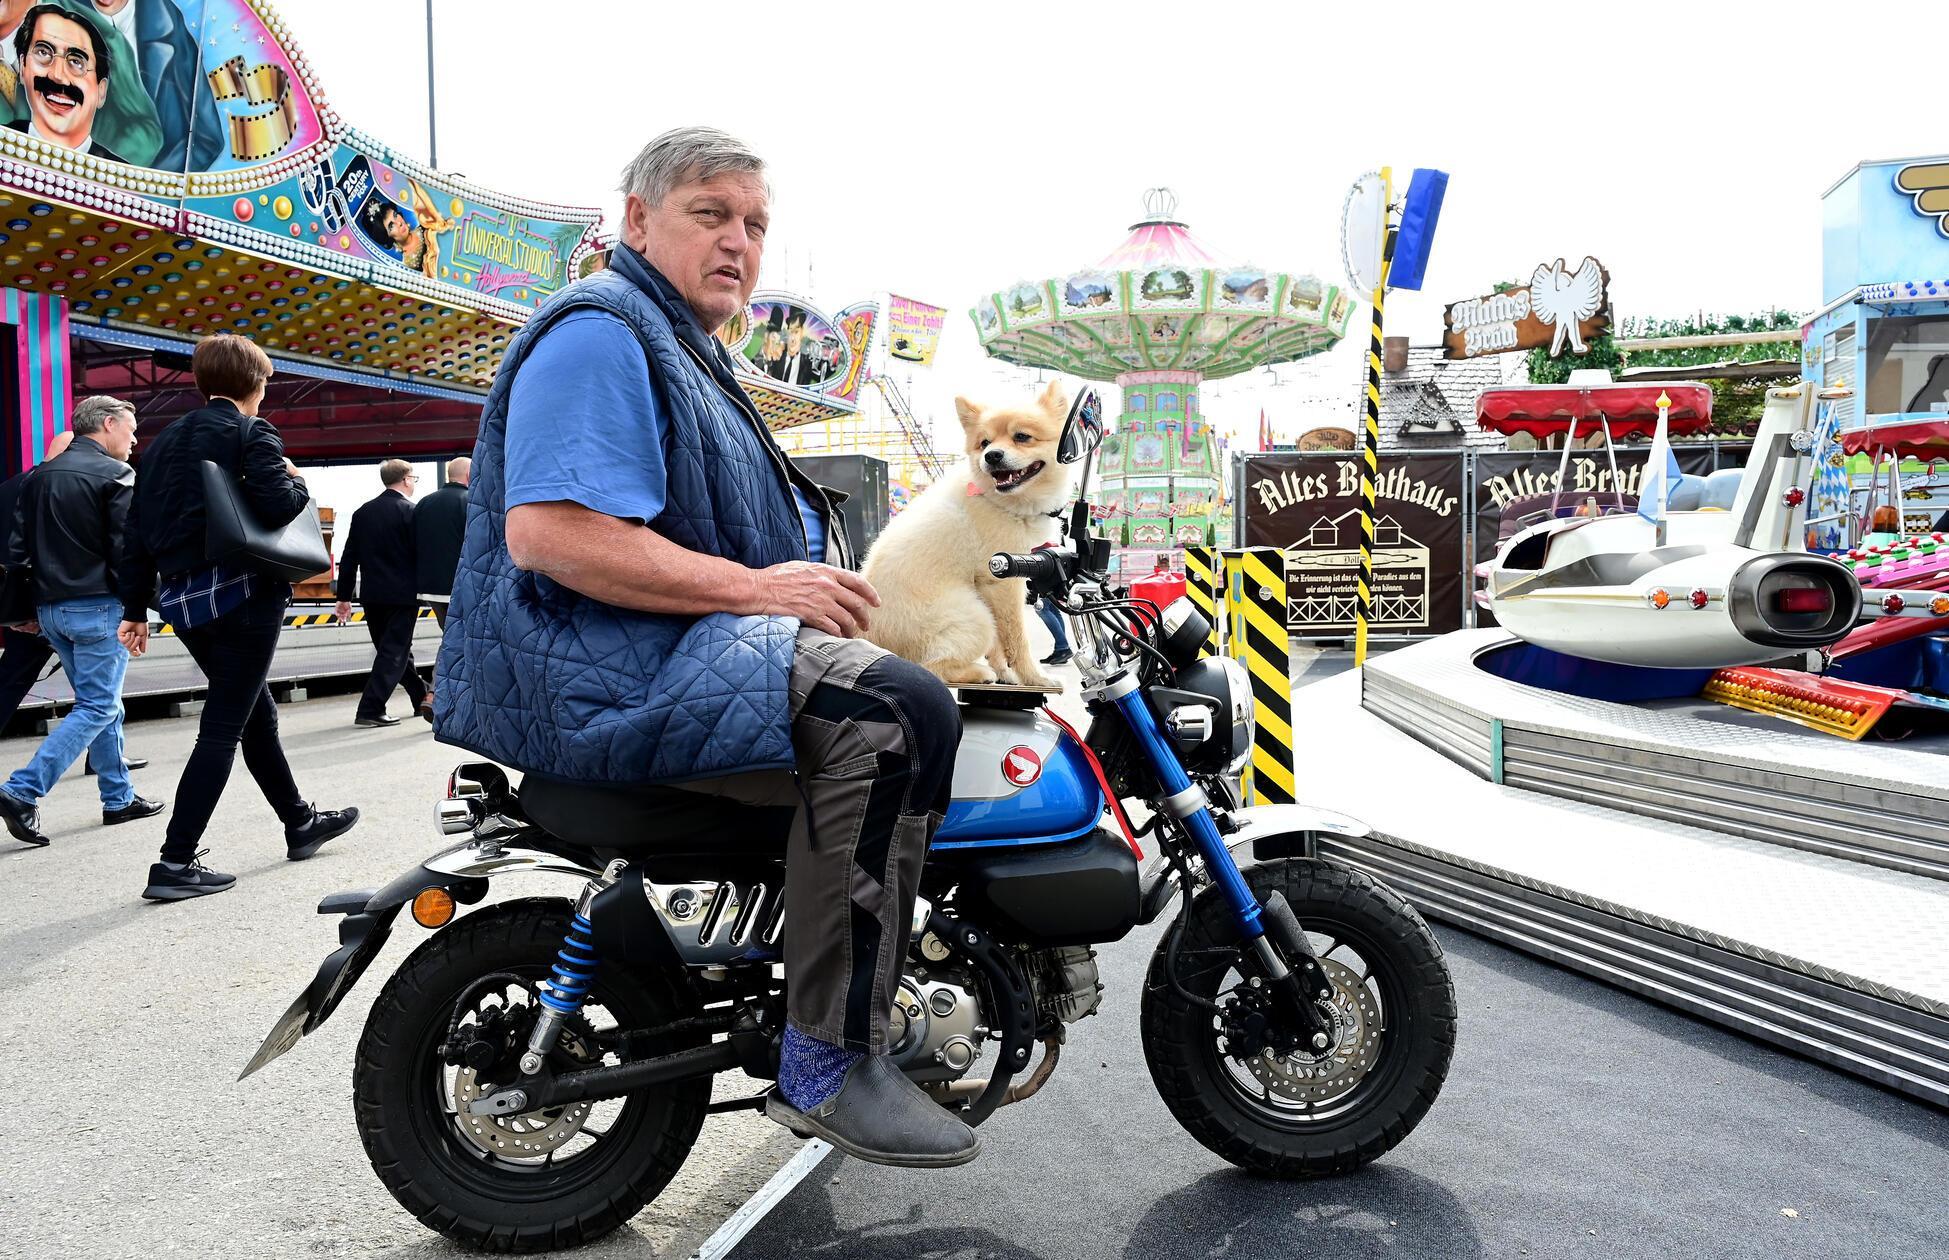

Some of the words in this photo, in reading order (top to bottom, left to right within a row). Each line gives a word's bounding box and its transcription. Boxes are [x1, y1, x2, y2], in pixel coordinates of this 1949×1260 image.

[343, 169, 362, 194] 20th
[347, 169, 369, 203] CENTURY
[357, 185, 368, 199] FOX
[463, 221, 513, 267] UNIVERSAL
[512, 239, 553, 281] STUDIOS
[475, 262, 539, 297] Hollywood
[1464, 325, 1518, 356] Bräu
[1251, 470, 1329, 515] Altes
[1481, 467, 1564, 512] Altes
[1289, 574, 1300, 583] Die
[1300, 573, 1332, 584] Erinnerung
[1333, 573, 1341, 582] ist
[1341, 573, 1353, 582] das
[1373, 573, 1398, 584] Paradies
[1410, 573, 1422, 581] dem
[1306, 585, 1317, 593] wir
[1317, 584, 1331, 593] nicht
[1382, 584, 1405, 593] können.
